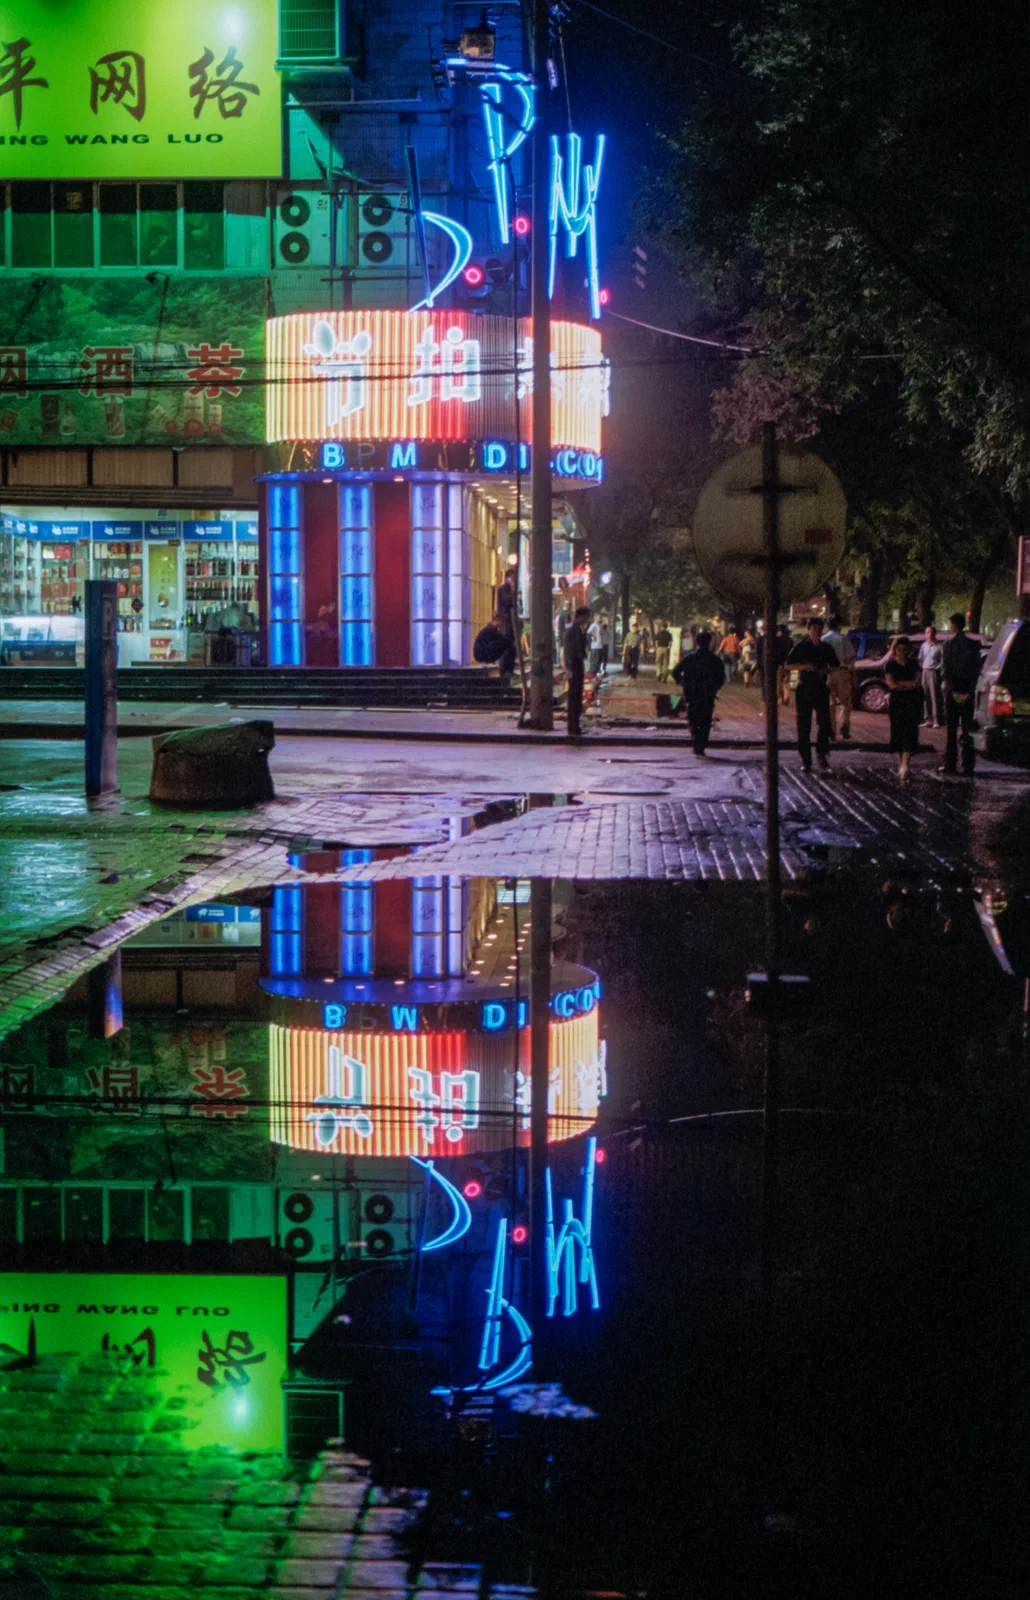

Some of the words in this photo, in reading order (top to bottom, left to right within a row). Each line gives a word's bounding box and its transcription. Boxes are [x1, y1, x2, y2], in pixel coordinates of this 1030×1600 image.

[65, 134, 149, 144] WANG
[167, 133, 224, 144] LUO
[322, 442, 417, 469] BPM
[483, 443, 596, 477] DICO
